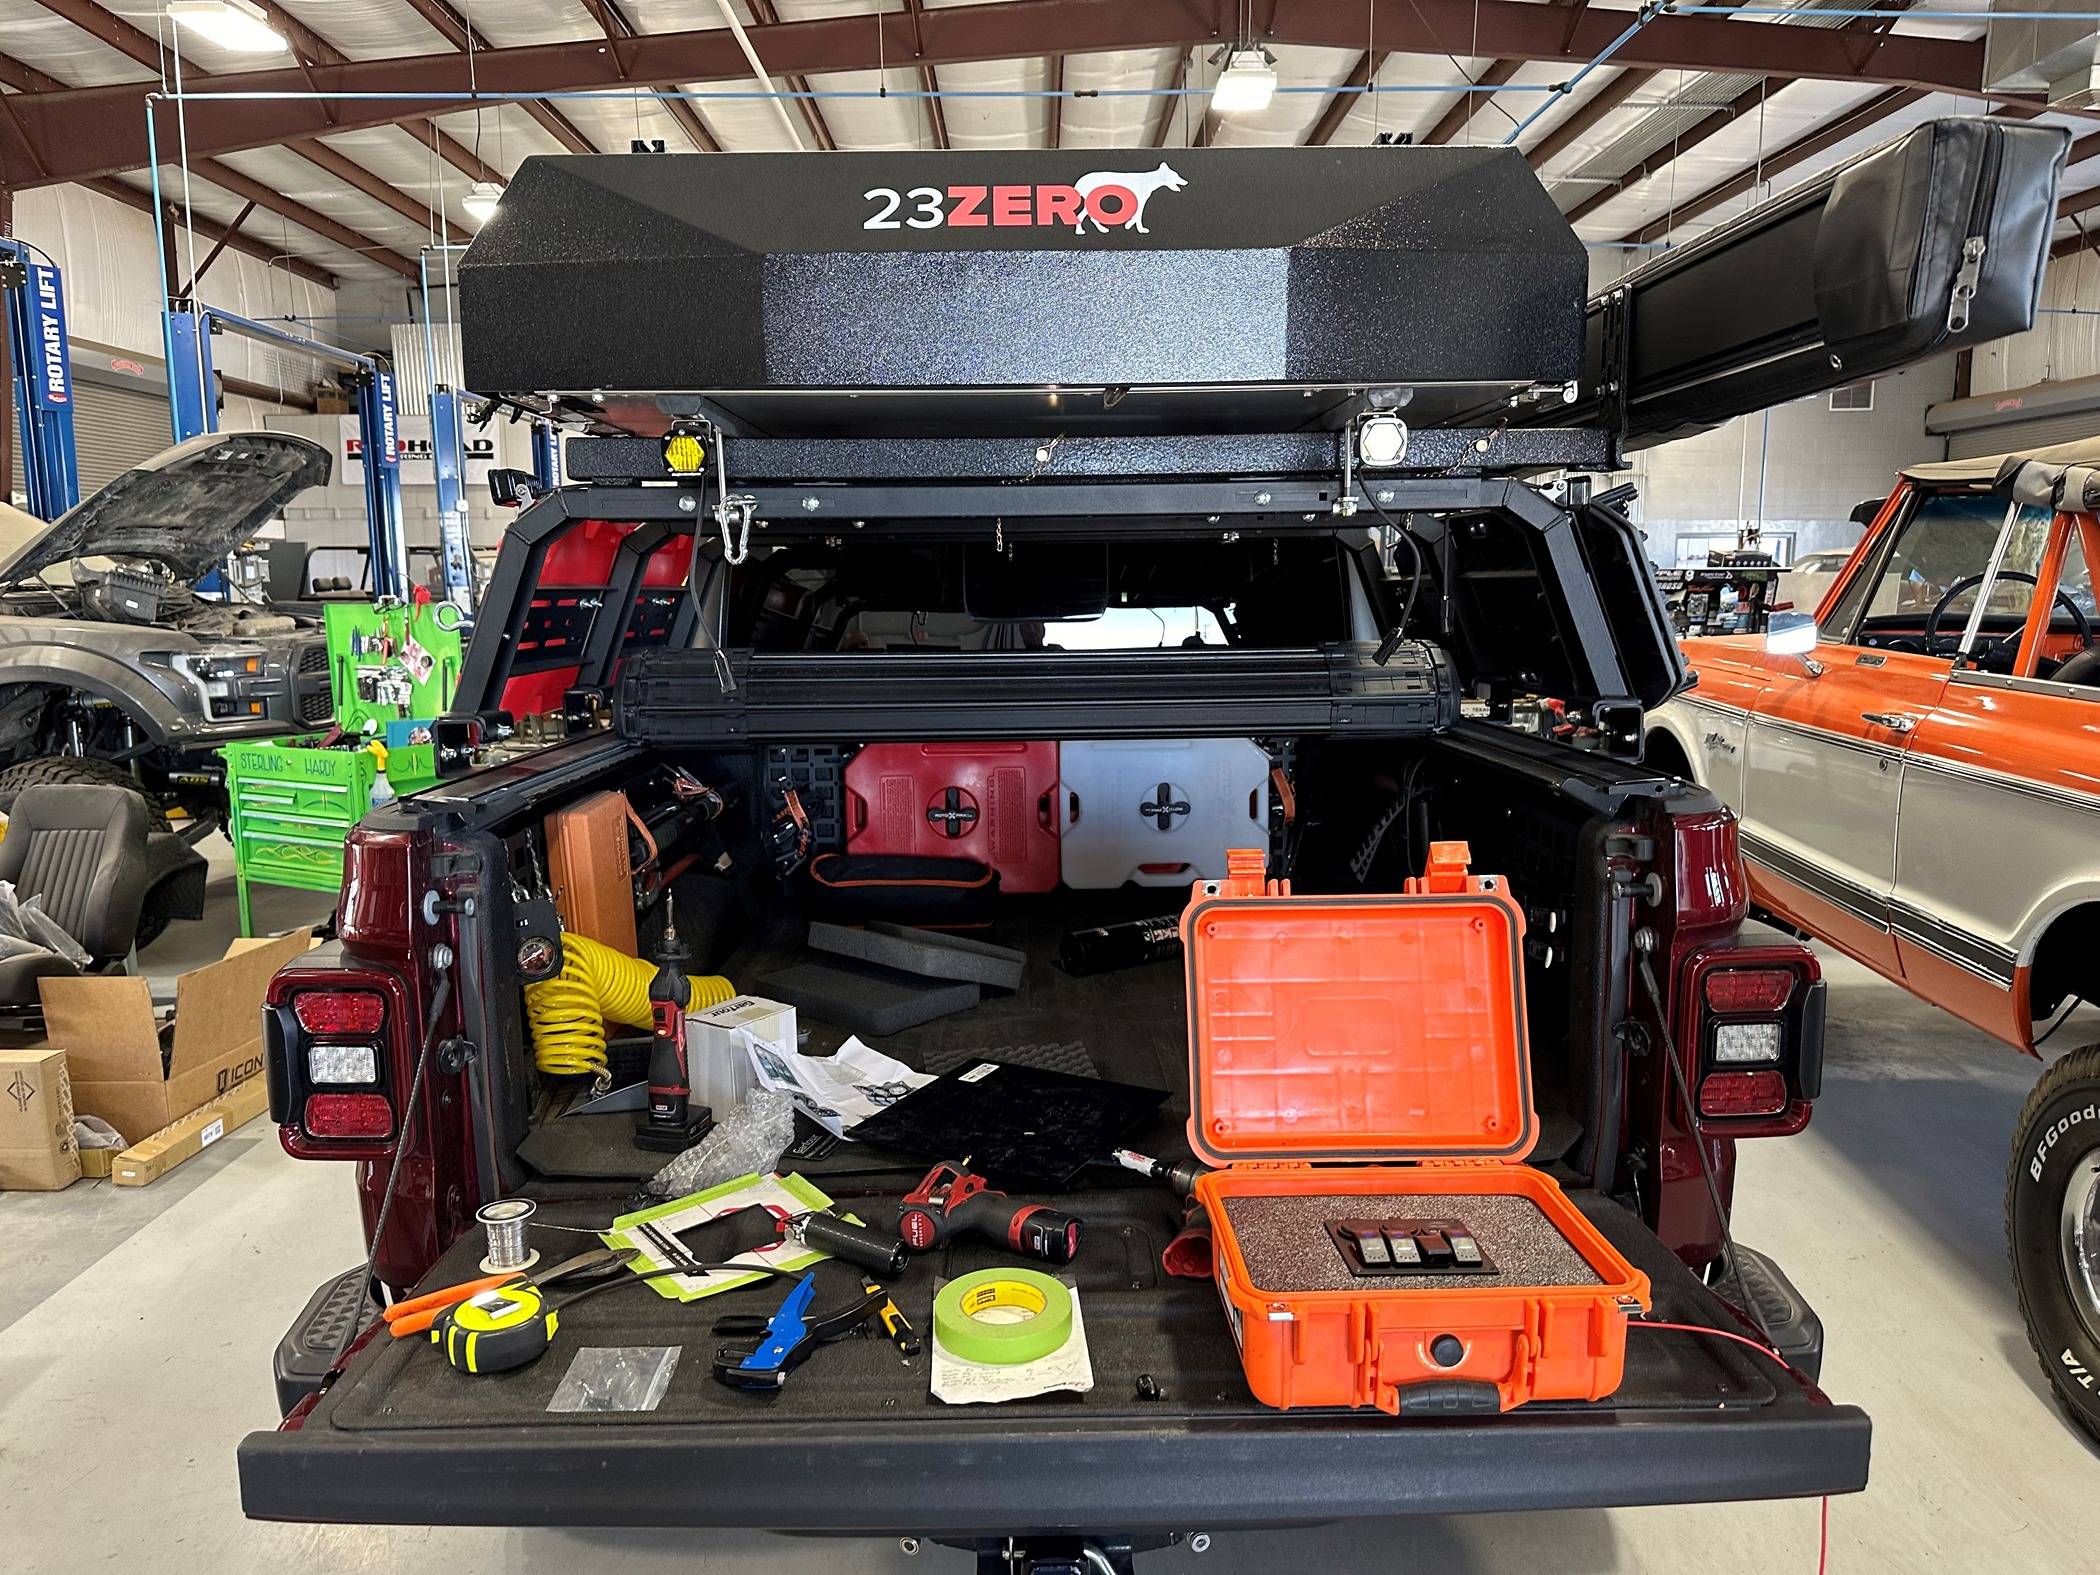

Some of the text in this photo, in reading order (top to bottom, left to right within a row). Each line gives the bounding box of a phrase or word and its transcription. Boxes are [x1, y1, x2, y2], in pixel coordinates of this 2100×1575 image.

[863, 184, 1138, 230] 23ZERO
[37, 266, 65, 393] ROTARY LIFT
[380, 373, 396, 457] ROTARY LIFT
[240, 754, 337, 777] STERLING HARDY
[231, 1054, 264, 1084] ICON
[2029, 1104, 2100, 1183] BFGood
[2061, 1348, 2094, 1389] T/A
